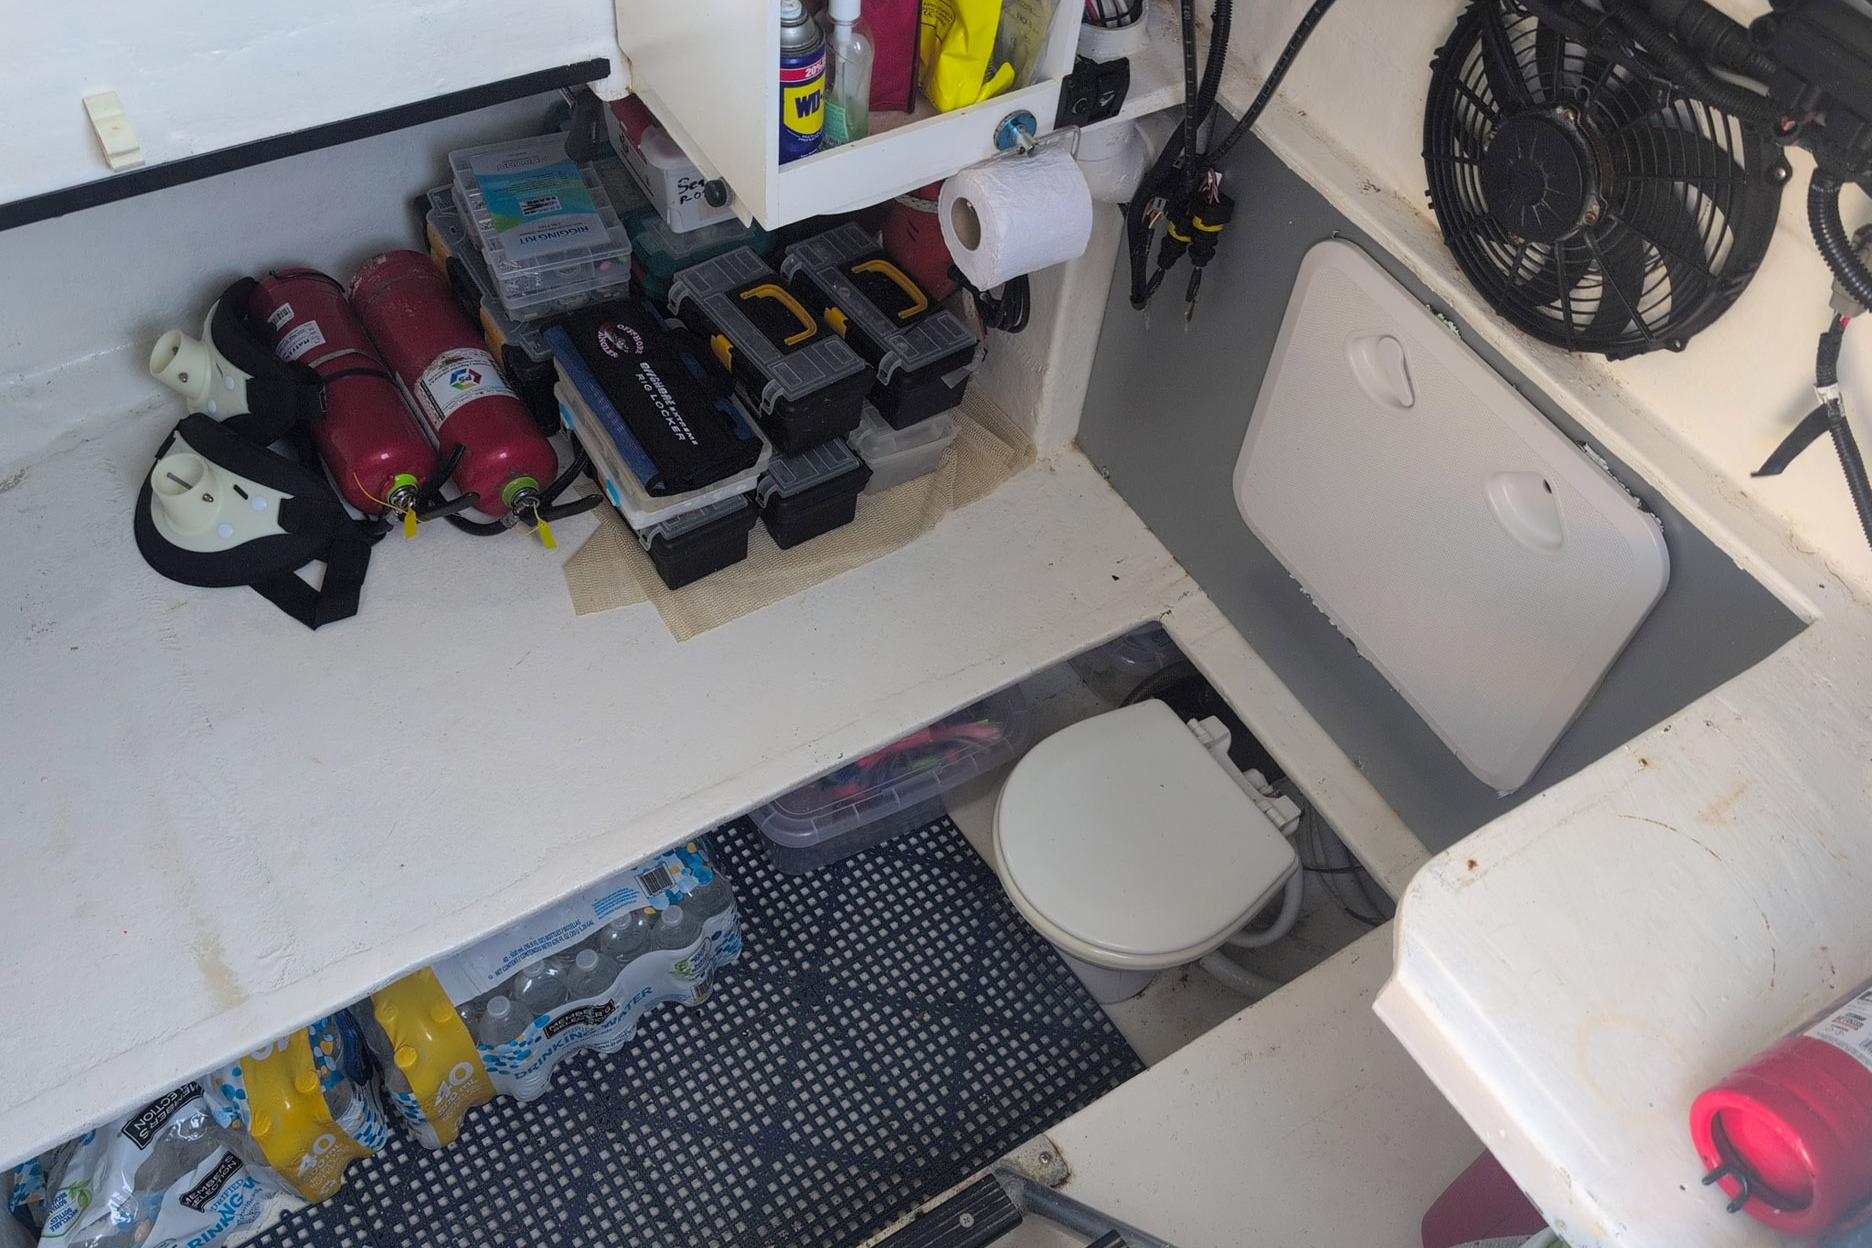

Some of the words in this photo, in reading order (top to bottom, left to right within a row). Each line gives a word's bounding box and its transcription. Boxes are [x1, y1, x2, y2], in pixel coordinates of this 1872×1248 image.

[635, 371, 652, 393] RIG
[649, 394, 685, 441] LOCKER
[639, 362, 675, 405] OFFSHORE
[668, 405, 698, 445] EXTREME
[513, 1027, 597, 1080] DRINKING
[602, 985, 653, 1029] WATER
[434, 1062, 474, 1105] 40
[298, 1135, 333, 1176] 40
[209, 1178, 243, 1210] URIFIED
